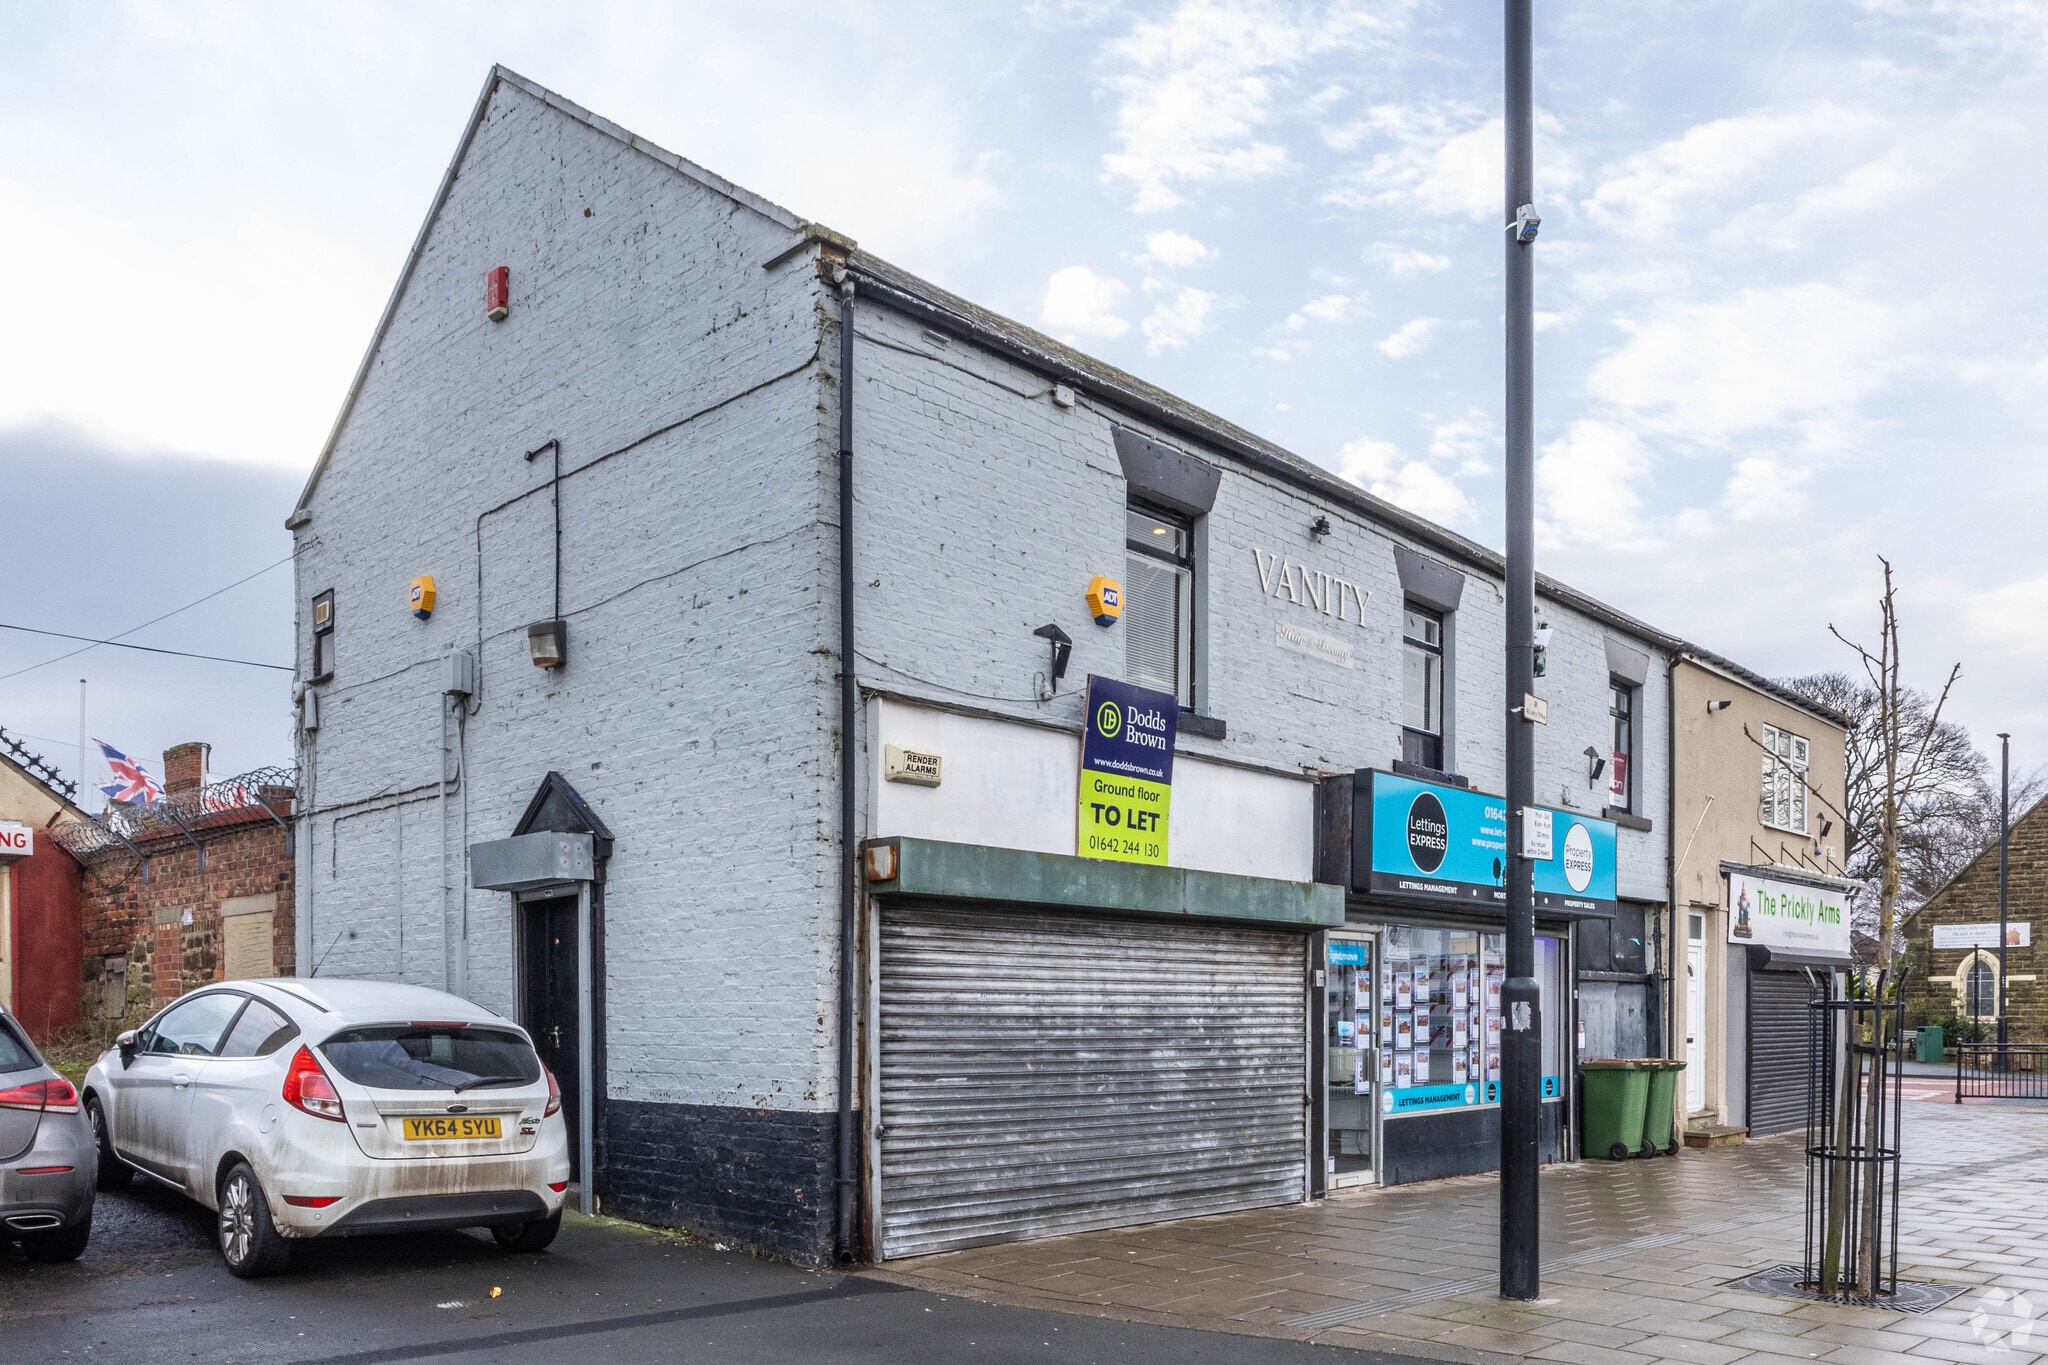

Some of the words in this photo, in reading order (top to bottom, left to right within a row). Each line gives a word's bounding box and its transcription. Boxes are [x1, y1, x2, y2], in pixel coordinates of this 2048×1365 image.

[1253, 547, 1373, 629] VANITY
[1103, 590, 1118, 605] ADT
[1127, 705, 1166, 732] Dodds
[1125, 724, 1166, 751] Brown
[906, 754, 938, 766] RENDER
[1094, 757, 1164, 778] www.doddsbrown.co.uk
[905, 763, 937, 775] ALARMS
[1094, 778, 1135, 799] Ground
[1137, 786, 1161, 803] floor
[1090, 802, 1121, 827] TO
[1126, 808, 1161, 833] LET
[1410, 815, 1446, 836] Lettings
[1480, 826, 1507, 838] www.let-
[1089, 835, 1119, 853] 01642
[1122, 840, 1140, 856] 244
[1144, 843, 1160, 858] 130
[1410, 832, 1446, 851] EXPRESS
[1471, 837, 1507, 851] www.proper
[1565, 844, 1592, 860] Property
[1565, 859, 1592, 873] EXPRESS
[1399, 880, 1424, 891] LETTINGS
[1423, 884, 1458, 895] MANAGEMENT
[1493, 891, 1507, 900] MORT
[1564, 899, 1584, 908] PROPERTY
[1583, 901, 1596, 910] SALES
[1757, 889, 1776, 916] The
[1781, 894, 1815, 928] Prickly
[1818, 899, 1841, 925] Arms
[1328, 950, 1359, 963] ightmove
[1398, 1096, 1425, 1107] LETTINGS
[1424, 1093, 1461, 1104] MANAGEMENT
[411, 1120, 458, 1136] YK64
[462, 1119, 496, 1135] SYU
